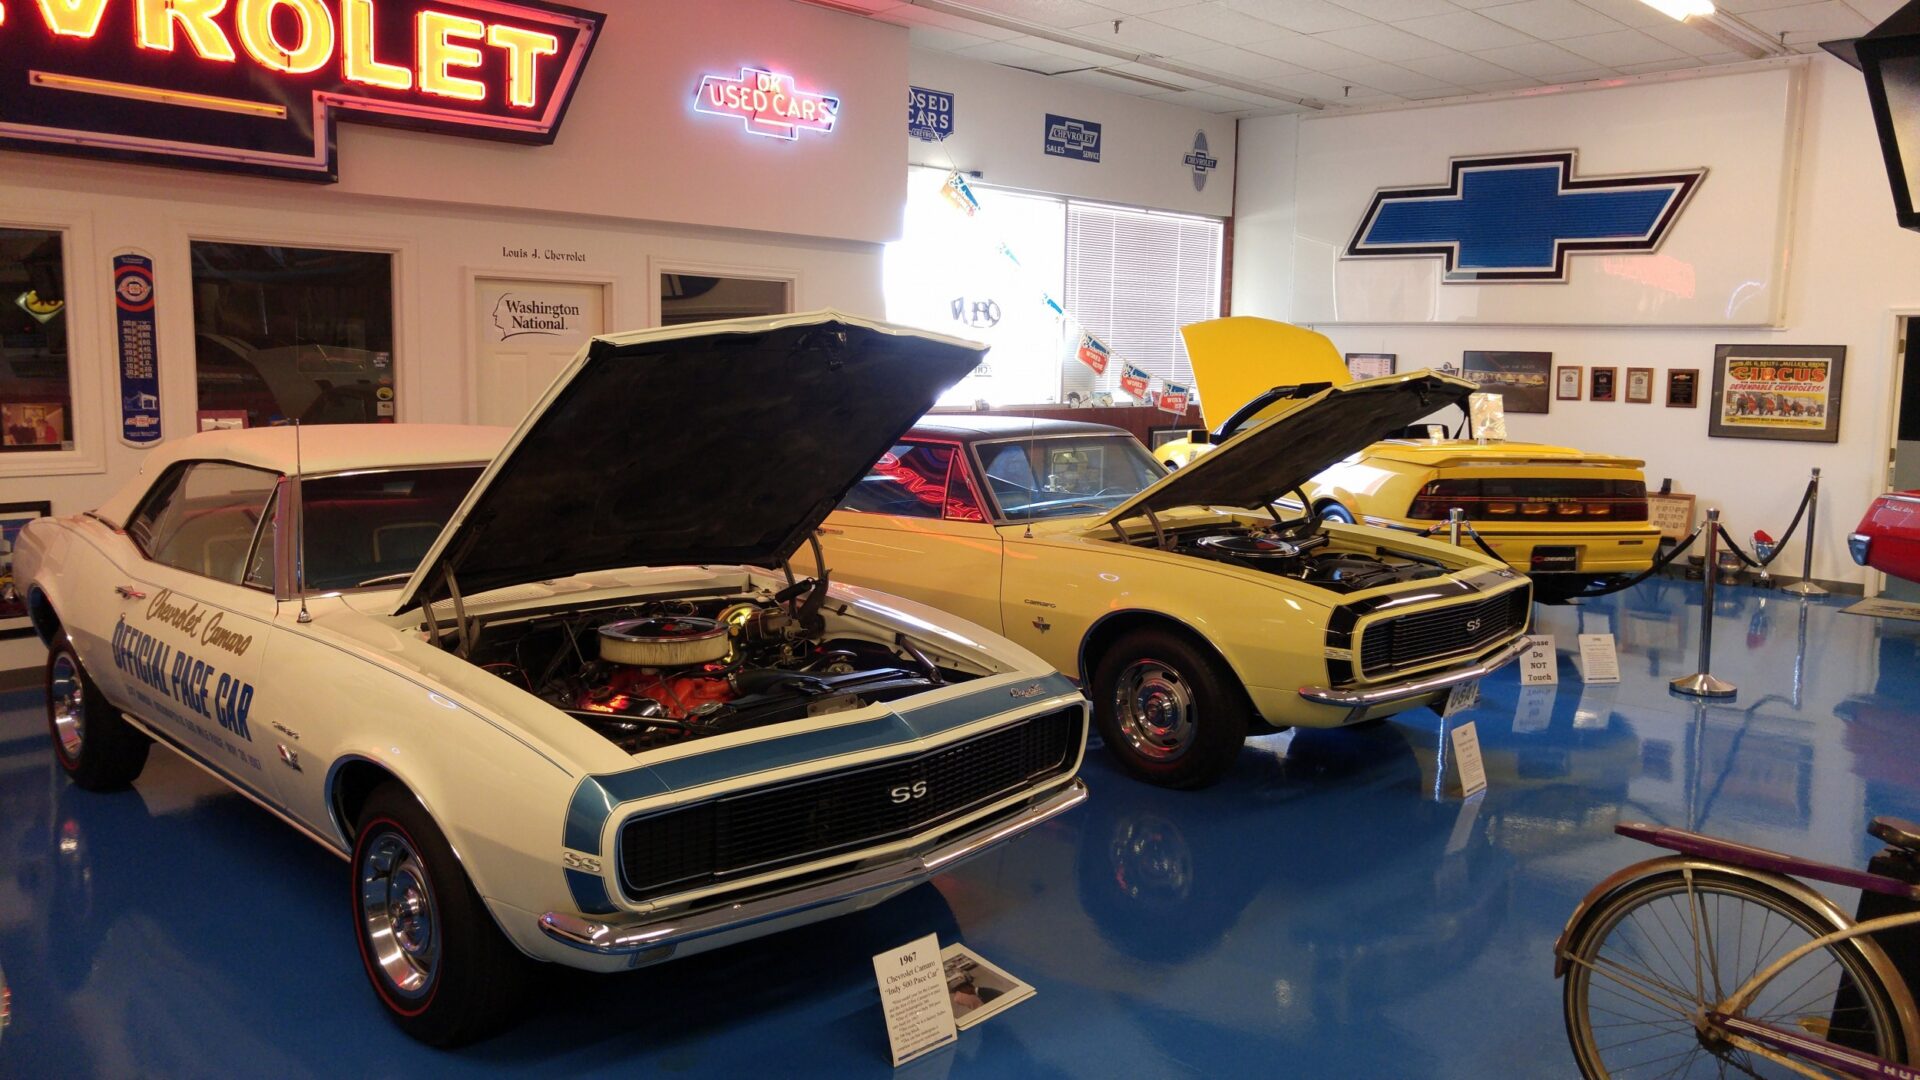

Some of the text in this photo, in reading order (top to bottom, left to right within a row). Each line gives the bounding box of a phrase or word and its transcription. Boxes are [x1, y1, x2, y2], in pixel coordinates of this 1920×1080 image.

[757, 73, 781, 92] OK
[709, 83, 832, 123] USED CARS
[1053, 128, 1093, 144] CHEVROLET
[1046, 145, 1100, 160] SALES SERVICE
[503, 246, 586, 262] Louis J. Chevrolet
[505, 299, 581, 319] Washington
[1730, 366, 1826, 383] CIRCUS
[1729, 383, 1772, 391] DEPENDABLE
[146, 588, 253, 657] Chevrolet Camaro
[1466, 618, 1481, 632] SS
[112, 620, 254, 743] OFFICIAL PACE CAR
[891, 781, 927, 804] SS
[563, 851, 602, 873] SS
[899, 951, 918, 966] 1967
[886, 960, 937, 985] Chevrolet Camaro
[902, 979, 914, 989] 500
[914, 974, 927, 985] Pace
